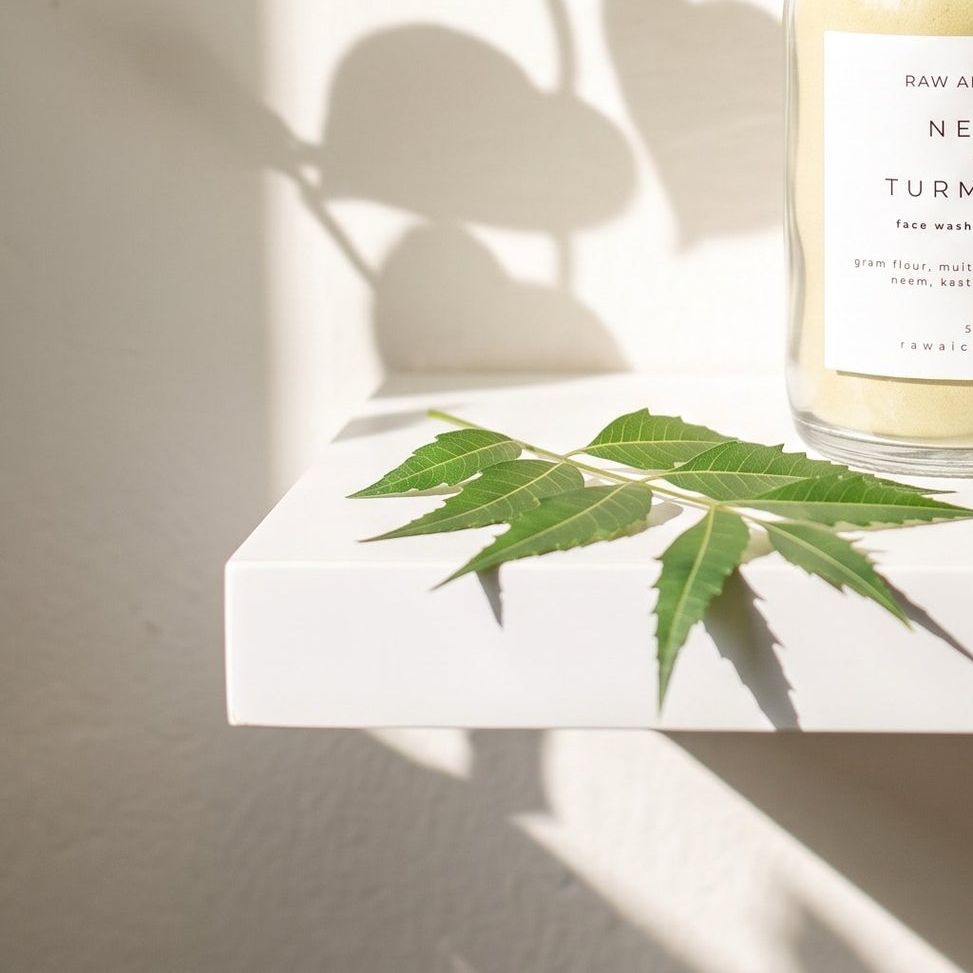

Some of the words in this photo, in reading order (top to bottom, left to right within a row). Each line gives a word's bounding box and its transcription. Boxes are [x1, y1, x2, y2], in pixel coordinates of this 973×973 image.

[905, 74, 949, 89] RAW
[895, 218, 927, 230] face
[934, 219, 972, 232] wash
[854, 258, 886, 269] gram
[892, 259, 932, 273] flour,
[890, 276, 933, 289] neem,
